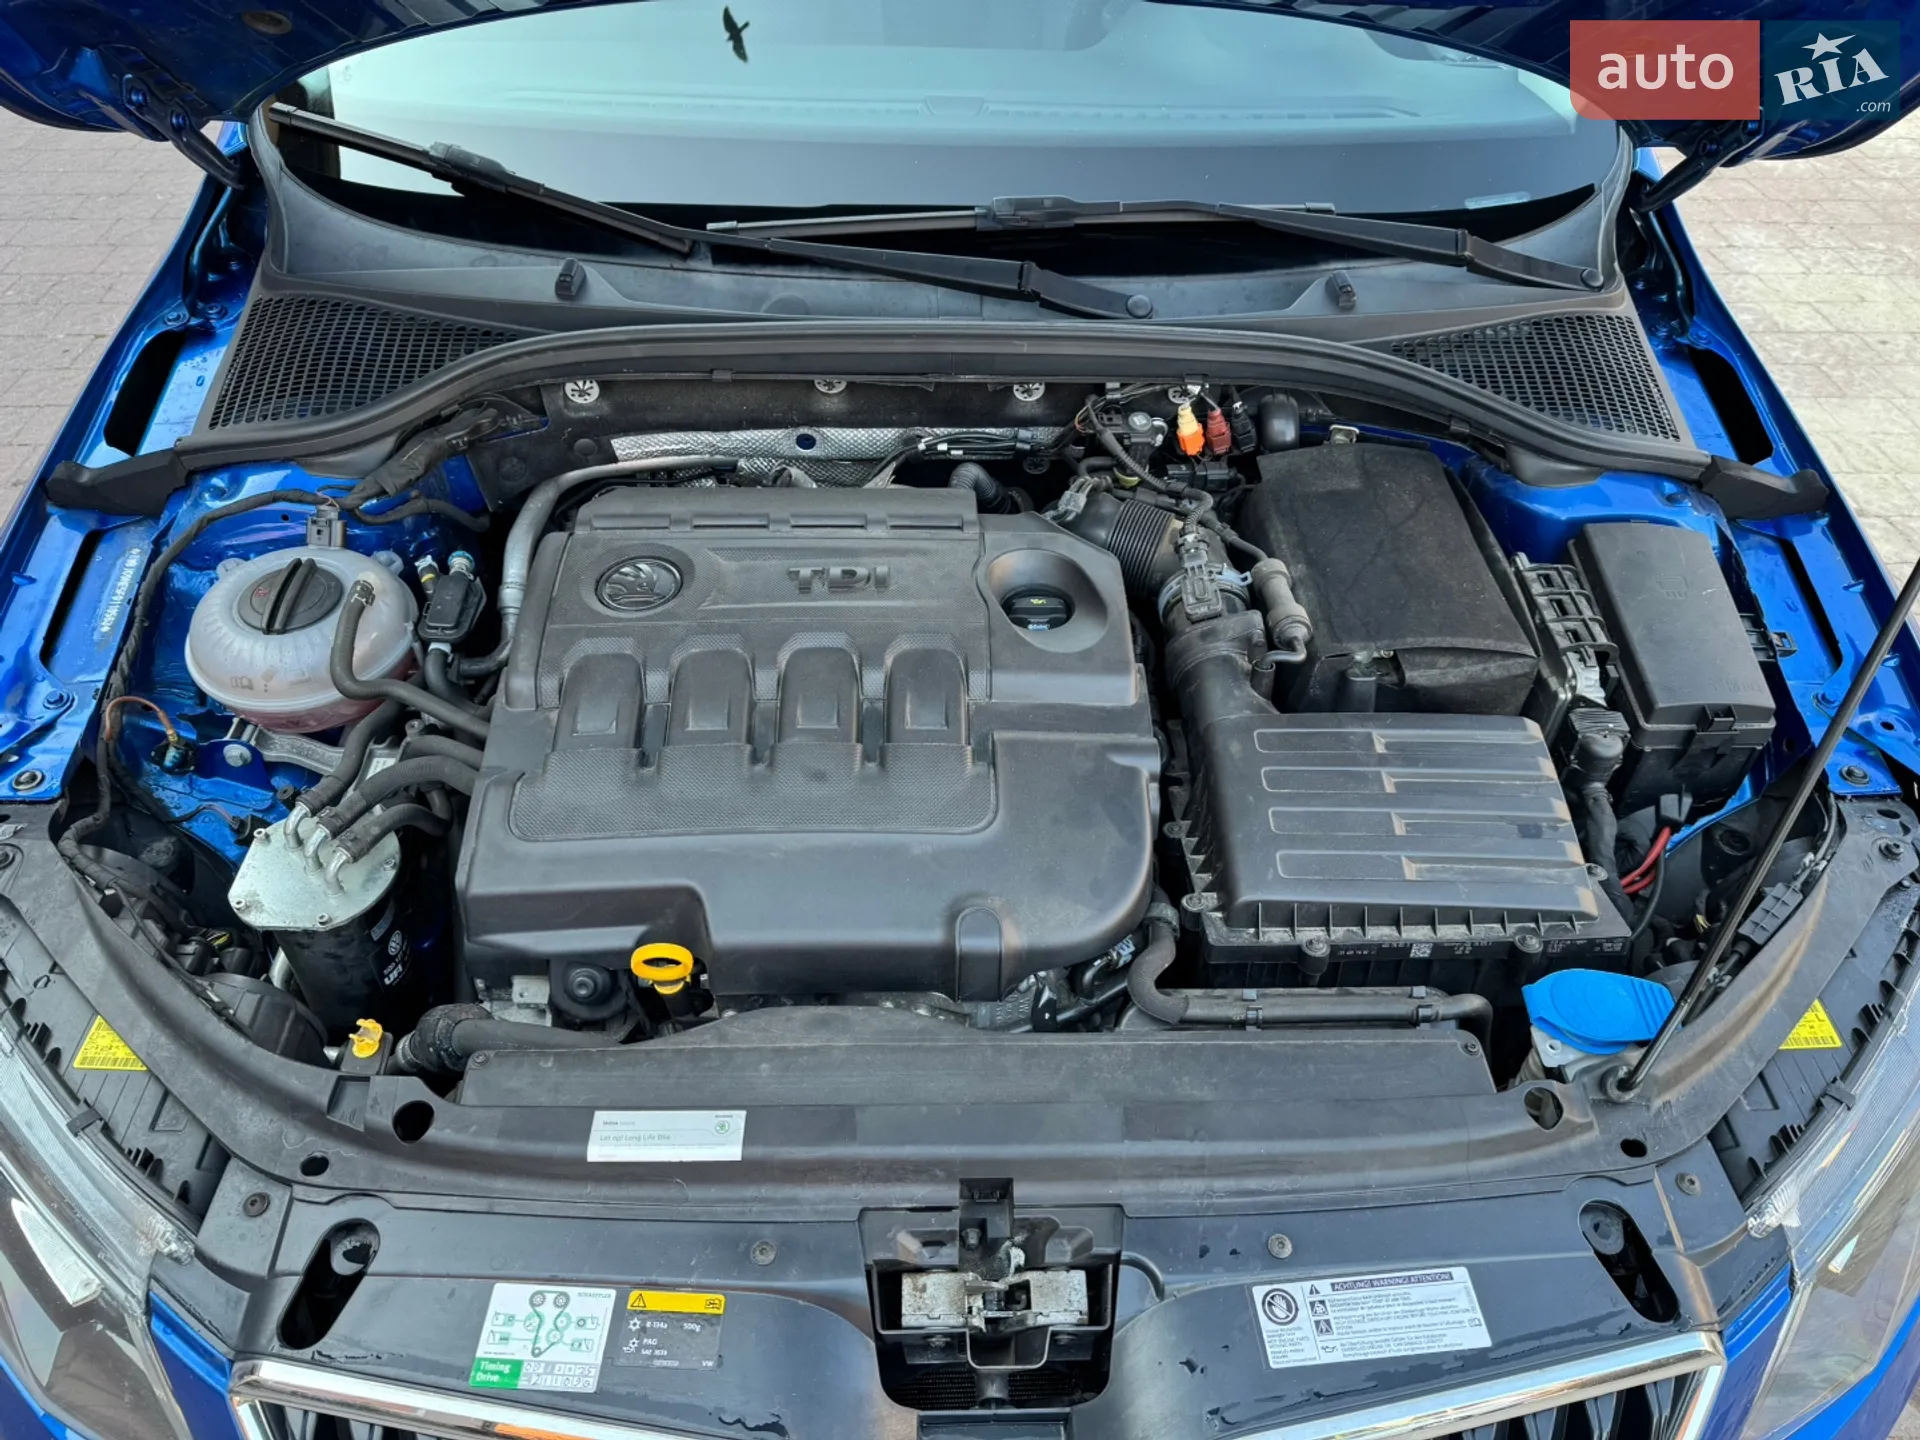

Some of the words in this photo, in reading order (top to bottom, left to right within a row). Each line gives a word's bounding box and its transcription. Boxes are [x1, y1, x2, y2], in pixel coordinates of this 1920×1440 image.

[788, 565, 891, 594] TDI
[624, 1134, 641, 1142] Long
[642, 1133, 656, 1141] Life
[1333, 1280, 1371, 1291] ACHTUNG!
[1372, 1276, 1408, 1288] WARNING!
[1410, 1273, 1450, 1285] ATTENTION!
[683, 1322, 701, 1332] 500g
[480, 1361, 511, 1374] Timing
[476, 1372, 499, 1382] Drive
